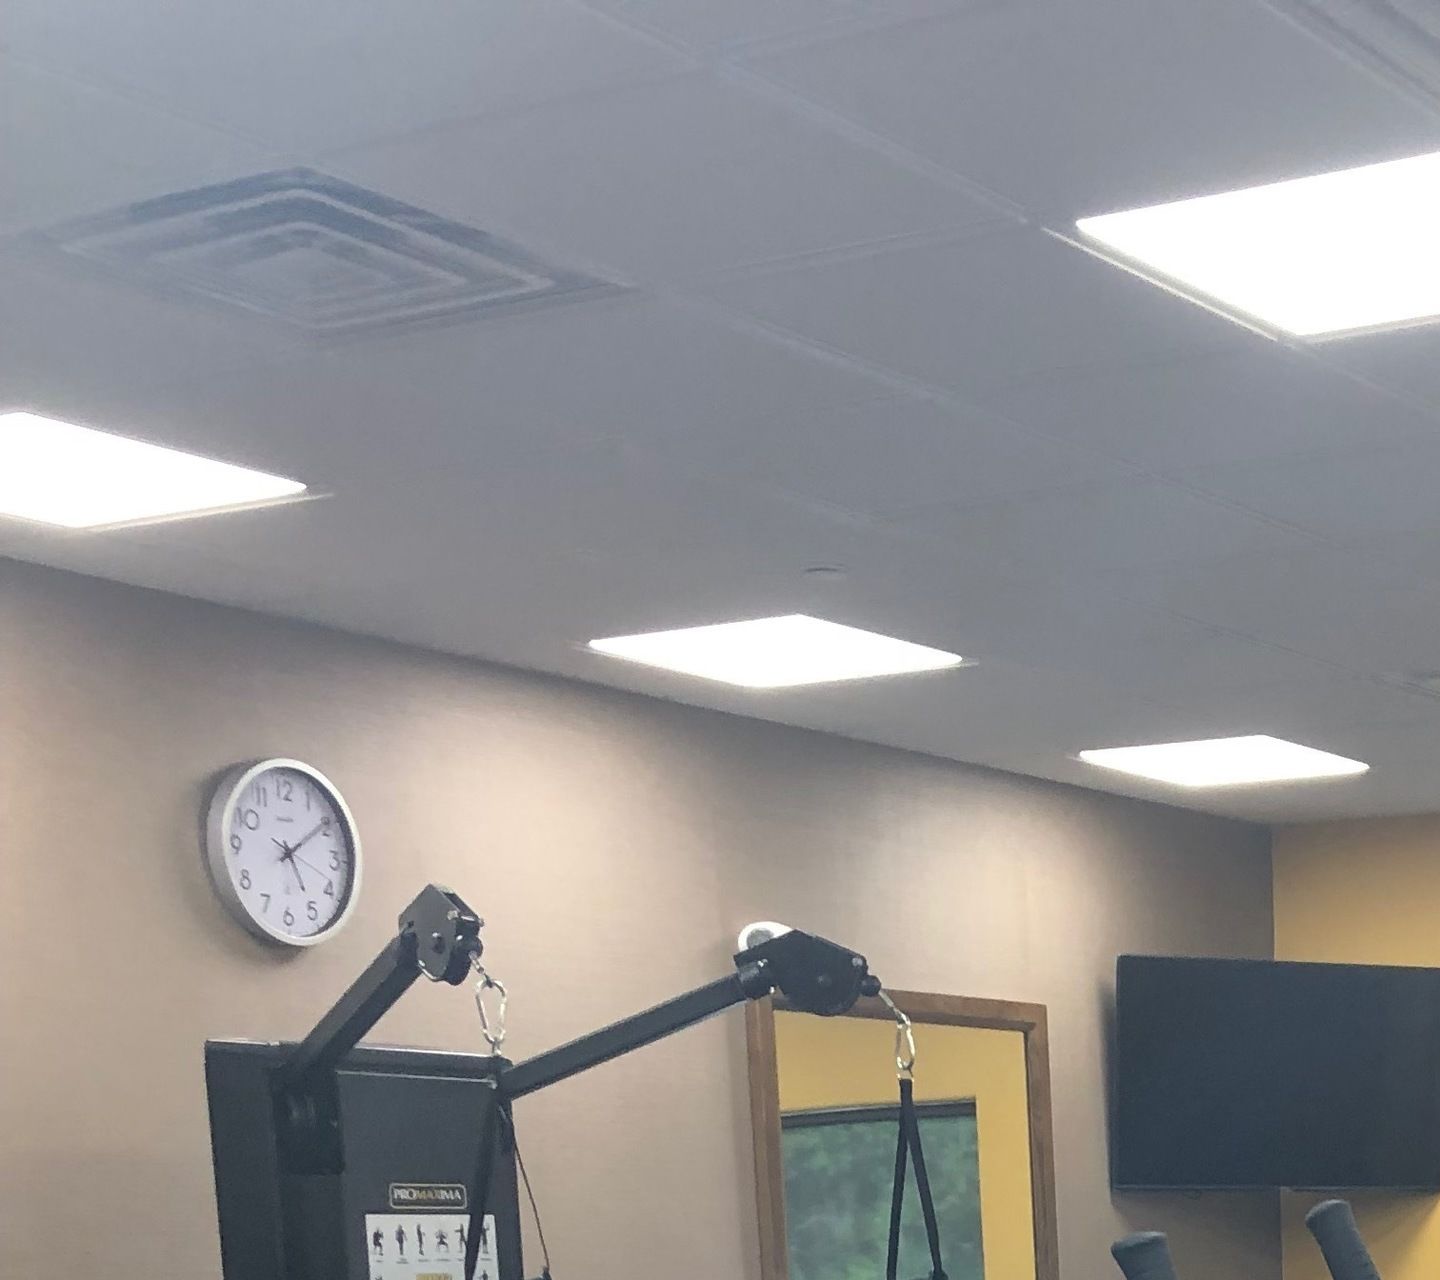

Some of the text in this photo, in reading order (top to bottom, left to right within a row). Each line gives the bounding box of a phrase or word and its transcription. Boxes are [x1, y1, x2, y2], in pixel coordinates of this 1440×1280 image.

[255, 784, 268, 808] 11
[275, 778, 293, 802] 12
[305, 790, 312, 812] 1
[236, 807, 259, 831] 10
[230, 834, 242, 855] 9
[329, 850, 340, 871] 3
[240, 868, 252, 890] 8
[323, 880, 334, 898] 4
[260, 892, 271, 913] 7
[307, 900, 318, 921] 5
[283, 905, 295, 927] 6
